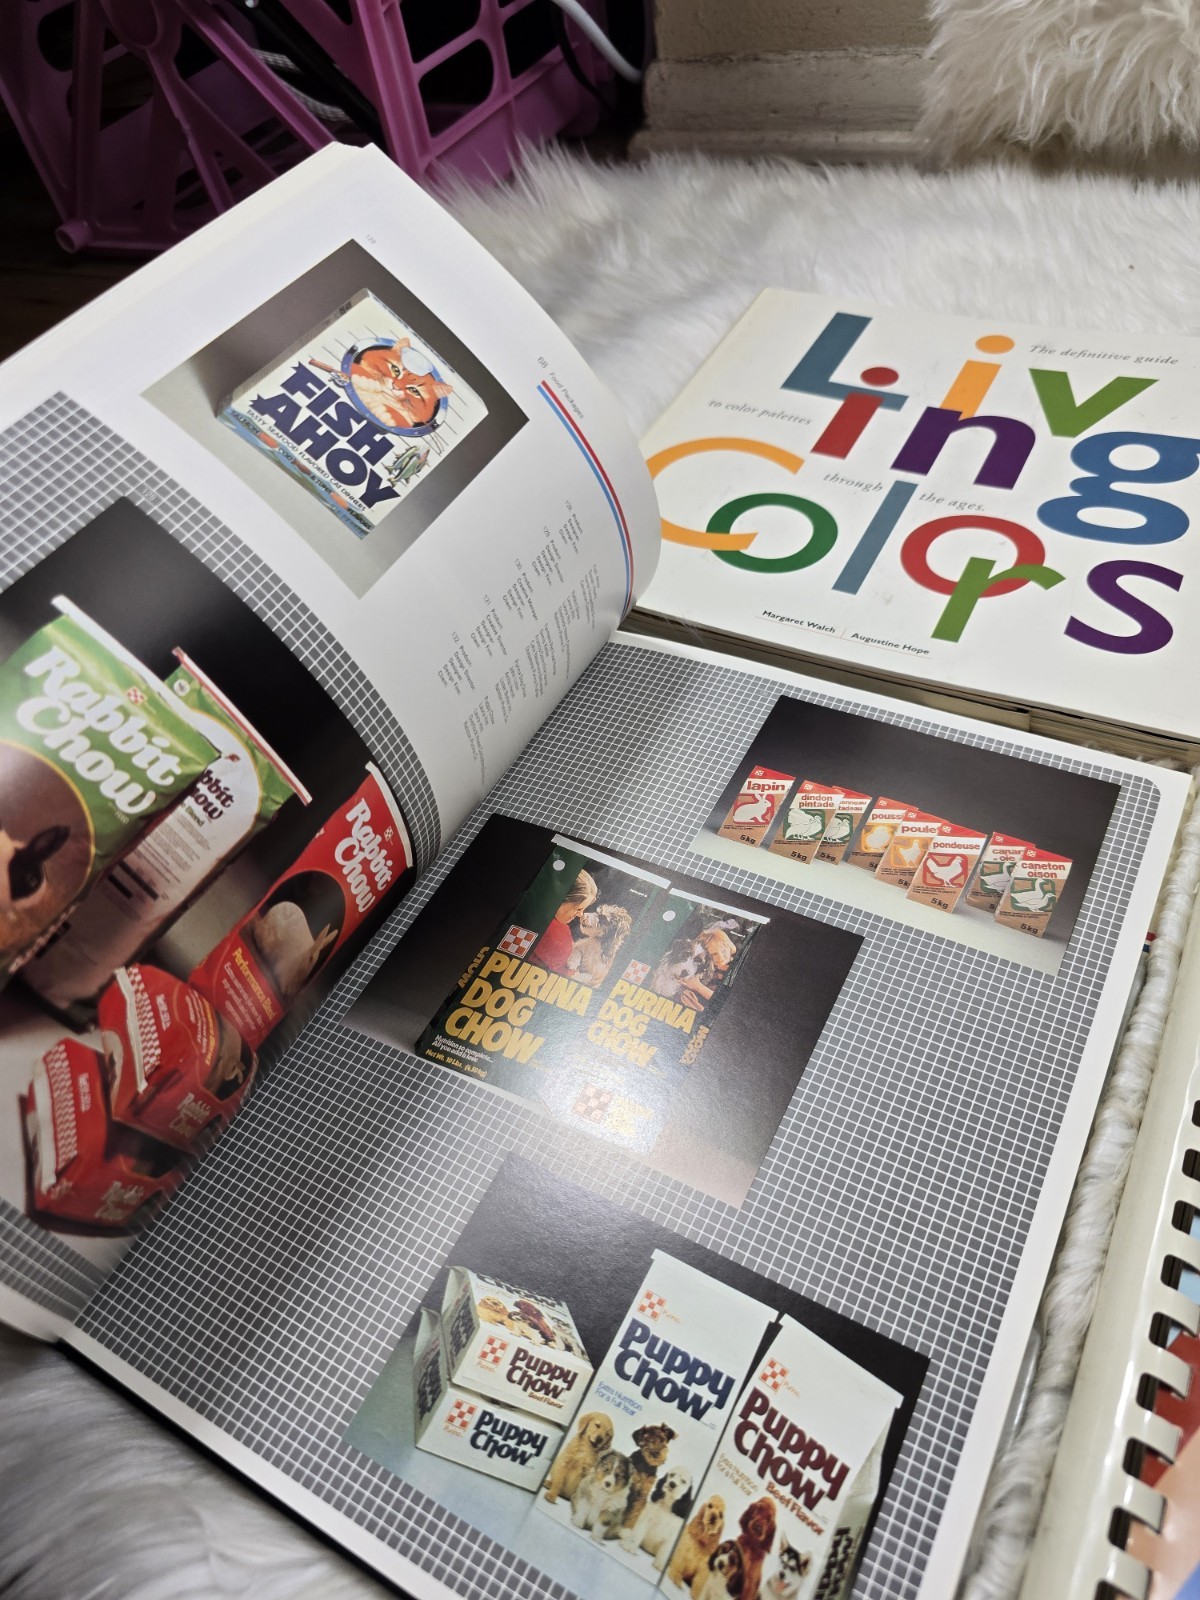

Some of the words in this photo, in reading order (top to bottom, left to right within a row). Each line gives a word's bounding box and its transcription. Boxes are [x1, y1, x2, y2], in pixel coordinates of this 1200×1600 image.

[1029, 344, 1056, 354] The
[1059, 348, 1131, 361] definitive
[1133, 355, 1179, 364] guide
[280, 361, 395, 466] FISH
[549, 372, 564, 389] Food
[562, 388, 584, 419] Packages
[708, 400, 722, 408] to
[724, 401, 757, 416] color
[759, 408, 812, 426] palettes
[246, 409, 266, 427] TASTY
[267, 423, 299, 453] SEAFOOD
[299, 450, 330, 481] FLAVORED
[329, 477, 342, 491] CAT
[341, 487, 367, 512] DINNERS
[249, 393, 401, 509] AHOY
[822, 473, 884, 492] through
[919, 492, 945, 505] the
[947, 498, 985, 512] ages.
[762, 609, 805, 626] Margaret
[807, 620, 836, 634] Walch
[851, 632, 900, 649] Augustine
[901, 644, 930, 656] Hope
[24, 644, 181, 787] Rabbit
[16, 696, 158, 816] Chow
[201, 769, 235, 809] bbit
[747, 781, 786, 793] lapin
[798, 801, 834, 809] pintade
[801, 794, 833, 802] dindon
[344, 798, 394, 892] Rabbit
[901, 825, 938, 834] poule
[933, 841, 980, 850] pondeuse
[333, 836, 378, 913] Chow
[1021, 862, 1066, 871] caneton
[1027, 869, 1058, 878] oison
[460, 977, 538, 1027] DOG
[479, 951, 593, 1017] PURINA
[608, 978, 697, 1034] PURINA
[445, 1007, 546, 1064] CHOW
[598, 999, 651, 1036] DOG
[587, 1020, 659, 1068] CHOW
[506, 1365, 566, 1399] Chow
[509, 1347, 578, 1391] Puppy
[614, 1349, 713, 1421] Chow
[618, 1317, 736, 1410] Puppy
[528, 1391, 544, 1403] Beef
[543, 1396, 564, 1409] Flavor
[470, 1429, 535, 1467] Chow
[473, 1410, 549, 1457] Puppy
[738, 1386, 851, 1501] Puppy
[734, 1418, 825, 1511] Chow
[766, 1480, 792, 1510] Beef
[789, 1499, 825, 1537] Flavor
